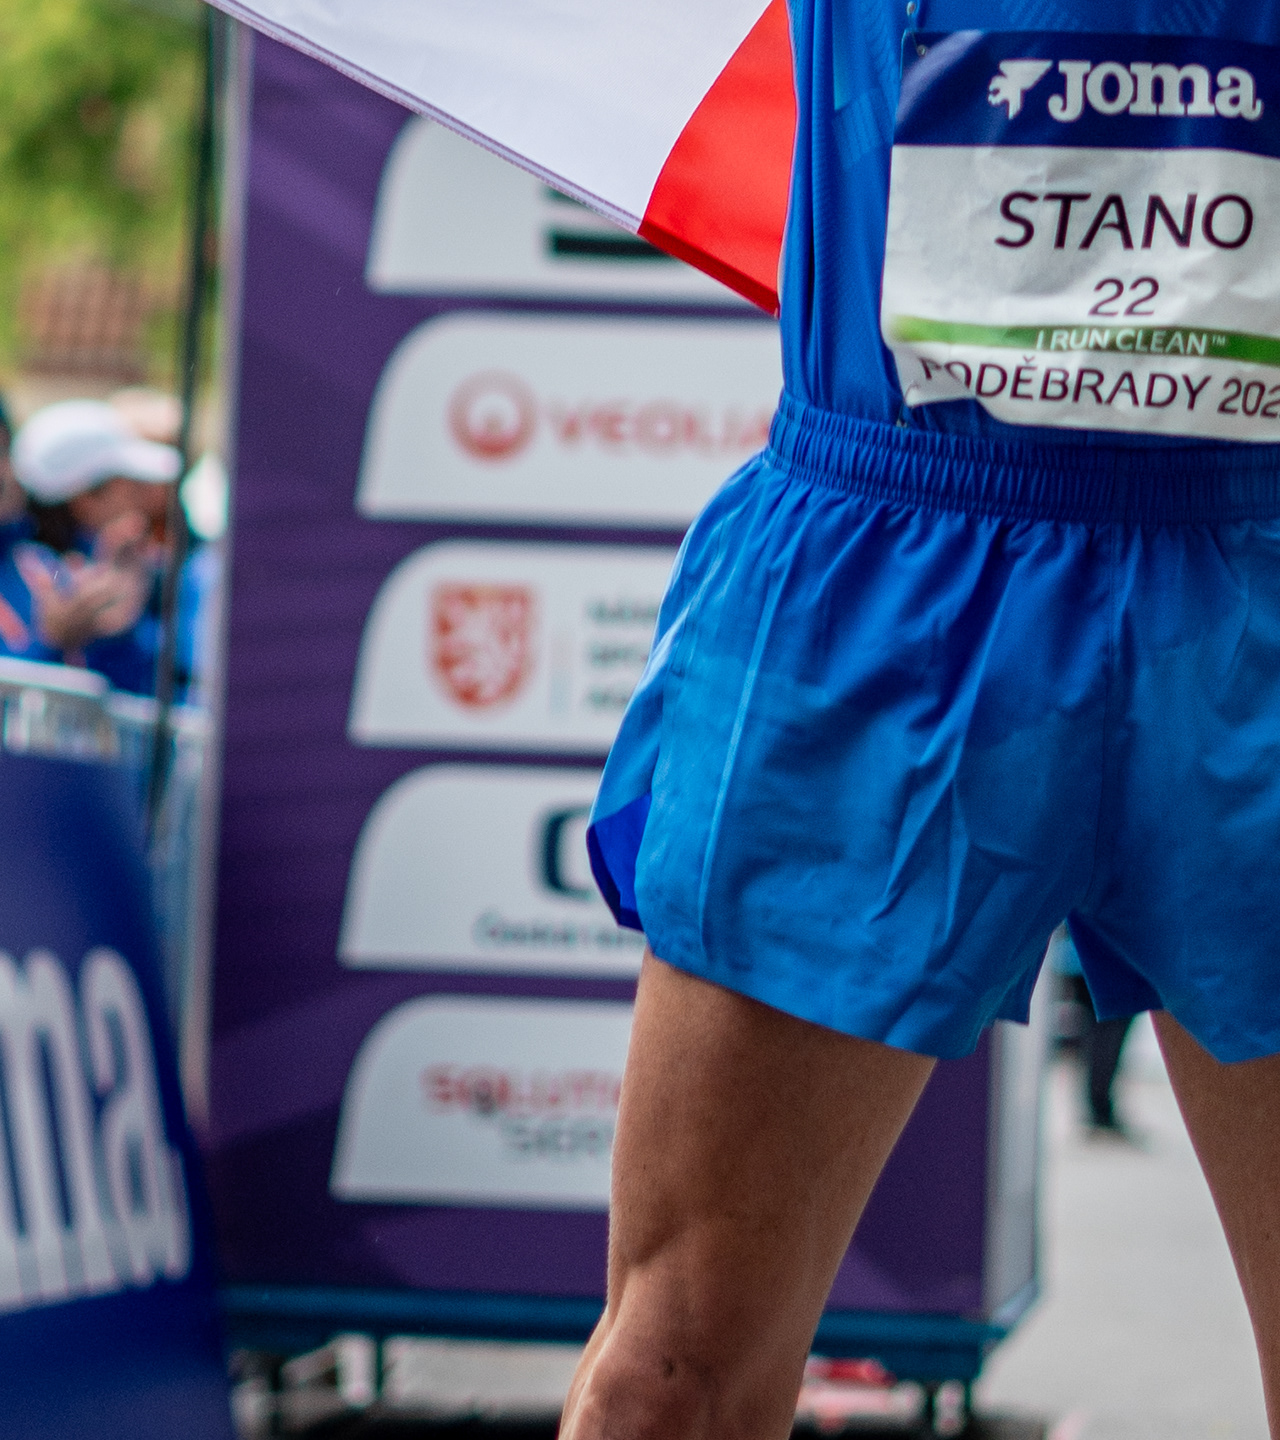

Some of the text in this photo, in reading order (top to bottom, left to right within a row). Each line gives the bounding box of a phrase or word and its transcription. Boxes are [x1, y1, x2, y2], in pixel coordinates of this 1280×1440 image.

[994, 190, 1255, 251] STANO
[1087, 276, 1160, 317] 22
[1035, 329, 1045, 350] I
[1049, 328, 1111, 352] RUN
